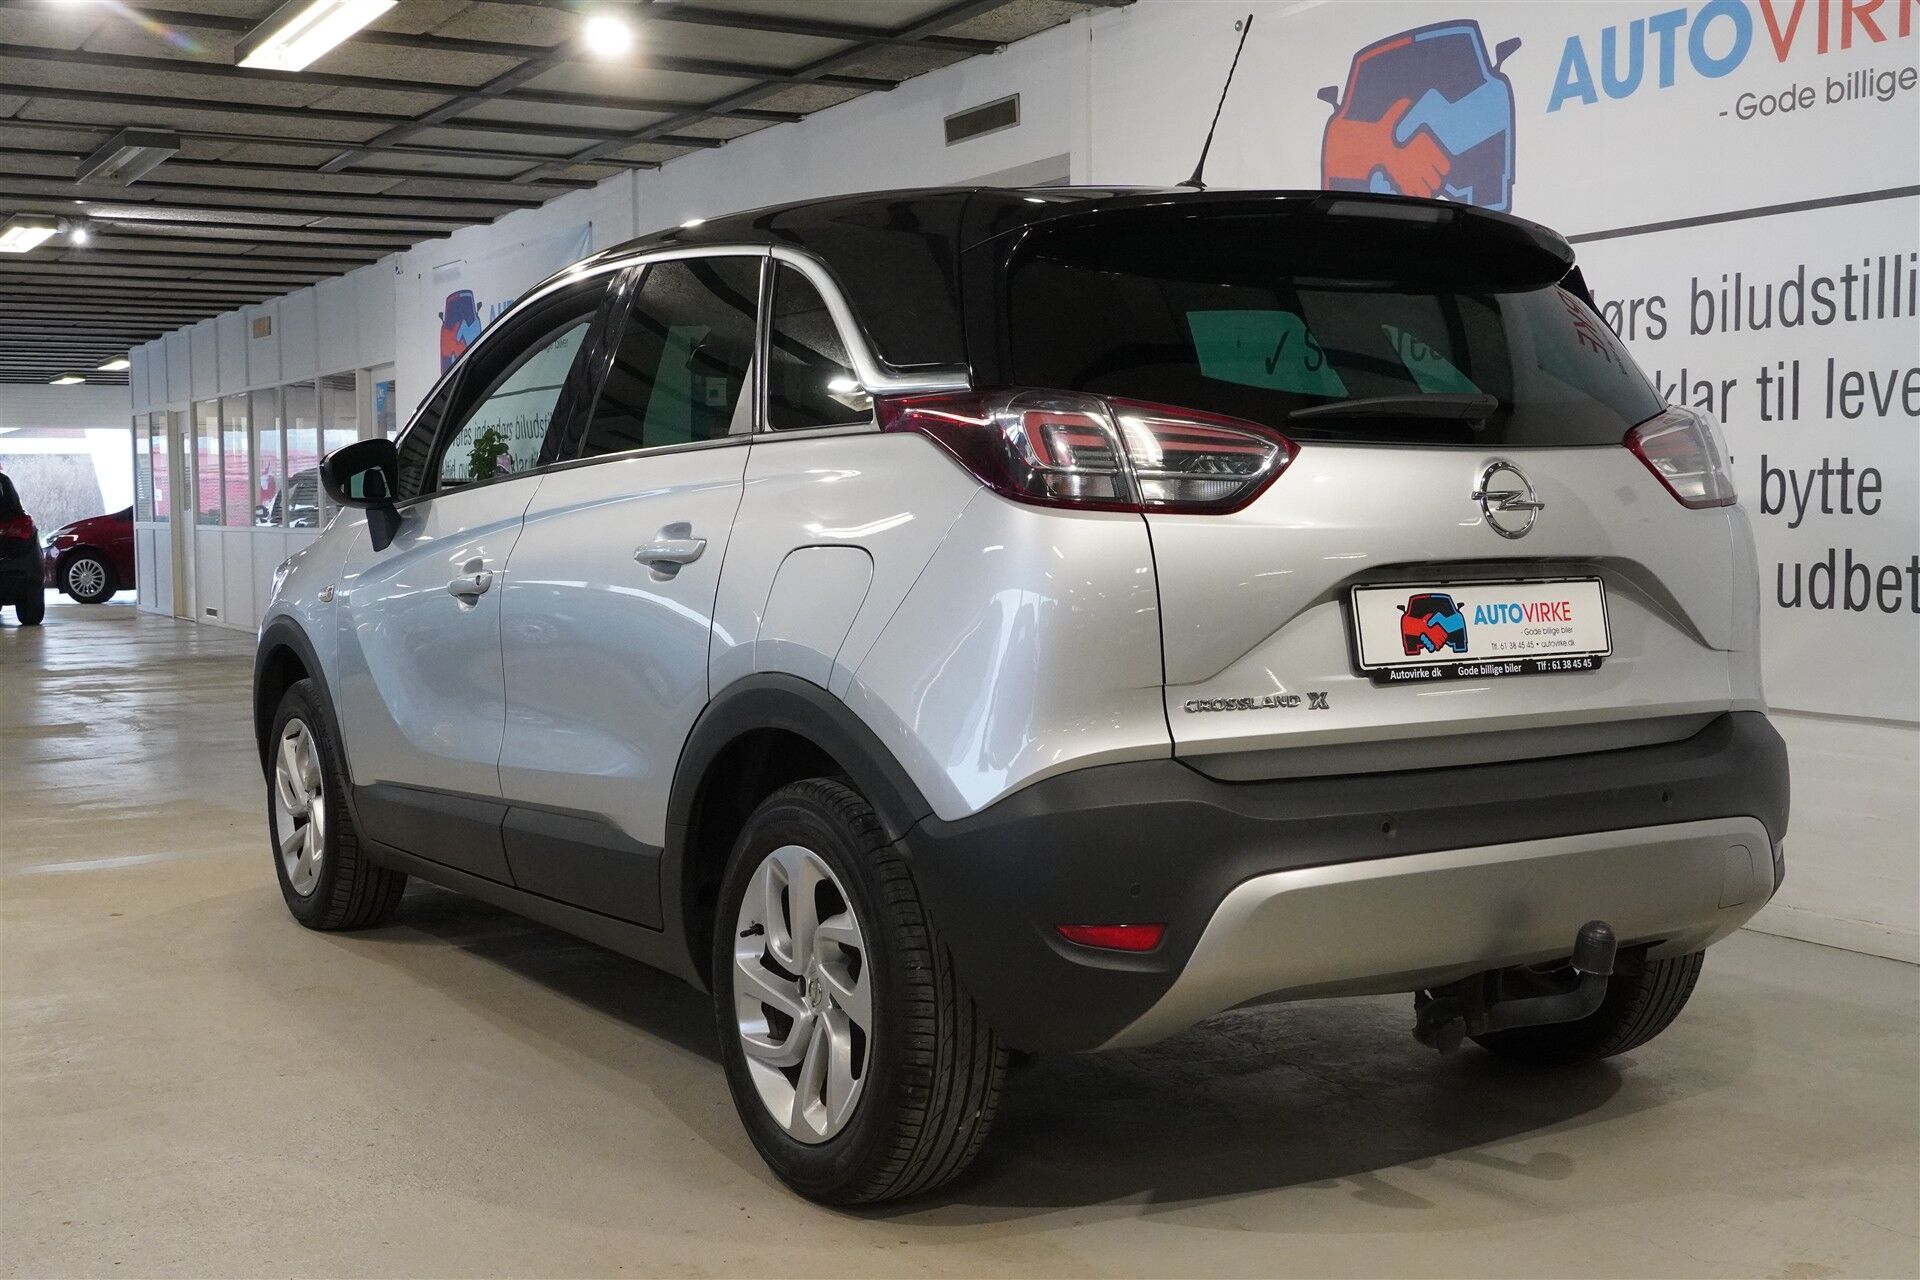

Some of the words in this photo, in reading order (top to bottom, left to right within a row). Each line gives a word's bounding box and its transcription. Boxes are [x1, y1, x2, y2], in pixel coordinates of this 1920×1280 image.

[1546, 0, 1920, 114] AUTOVIR
[1735, 84, 1816, 120] Gode
[1826, 67, 1918, 101] billige
[1590, 289, 1667, 341] ørs
[1690, 252, 1918, 336] biludstilli
[1756, 359, 1799, 422] til
[1826, 357, 1920, 419] leve
[1761, 454, 1882, 529] bytte
[1776, 548, 1920, 614] udbet
[1473, 602, 1572, 625] AUTOVIRKE
[1524, 627, 1542, 636] Gode
[1542, 627, 1560, 637] billige
[1560, 626, 1574, 634] biler
[1390, 668, 1430, 680] Autovirke
[1431, 667, 1442, 678] dk
[1458, 666, 1479, 677] Gode
[1480, 665, 1503, 677] billige
[1504, 663, 1522, 674] biler
[1551, 660, 1561, 670] 61
[1562, 660, 1572, 669] 38
[1573, 659, 1582, 669] 45
[1583, 658, 1592, 668] 45
[1500, 642, 1508, 650] 61
[1509, 641, 1517, 650] 38
[1518, 641, 1526, 649] 45
[1526, 640, 1535, 649] 45
[1183, 695, 1301, 713] CROSSLAND
[1306, 691, 1330, 710] X
